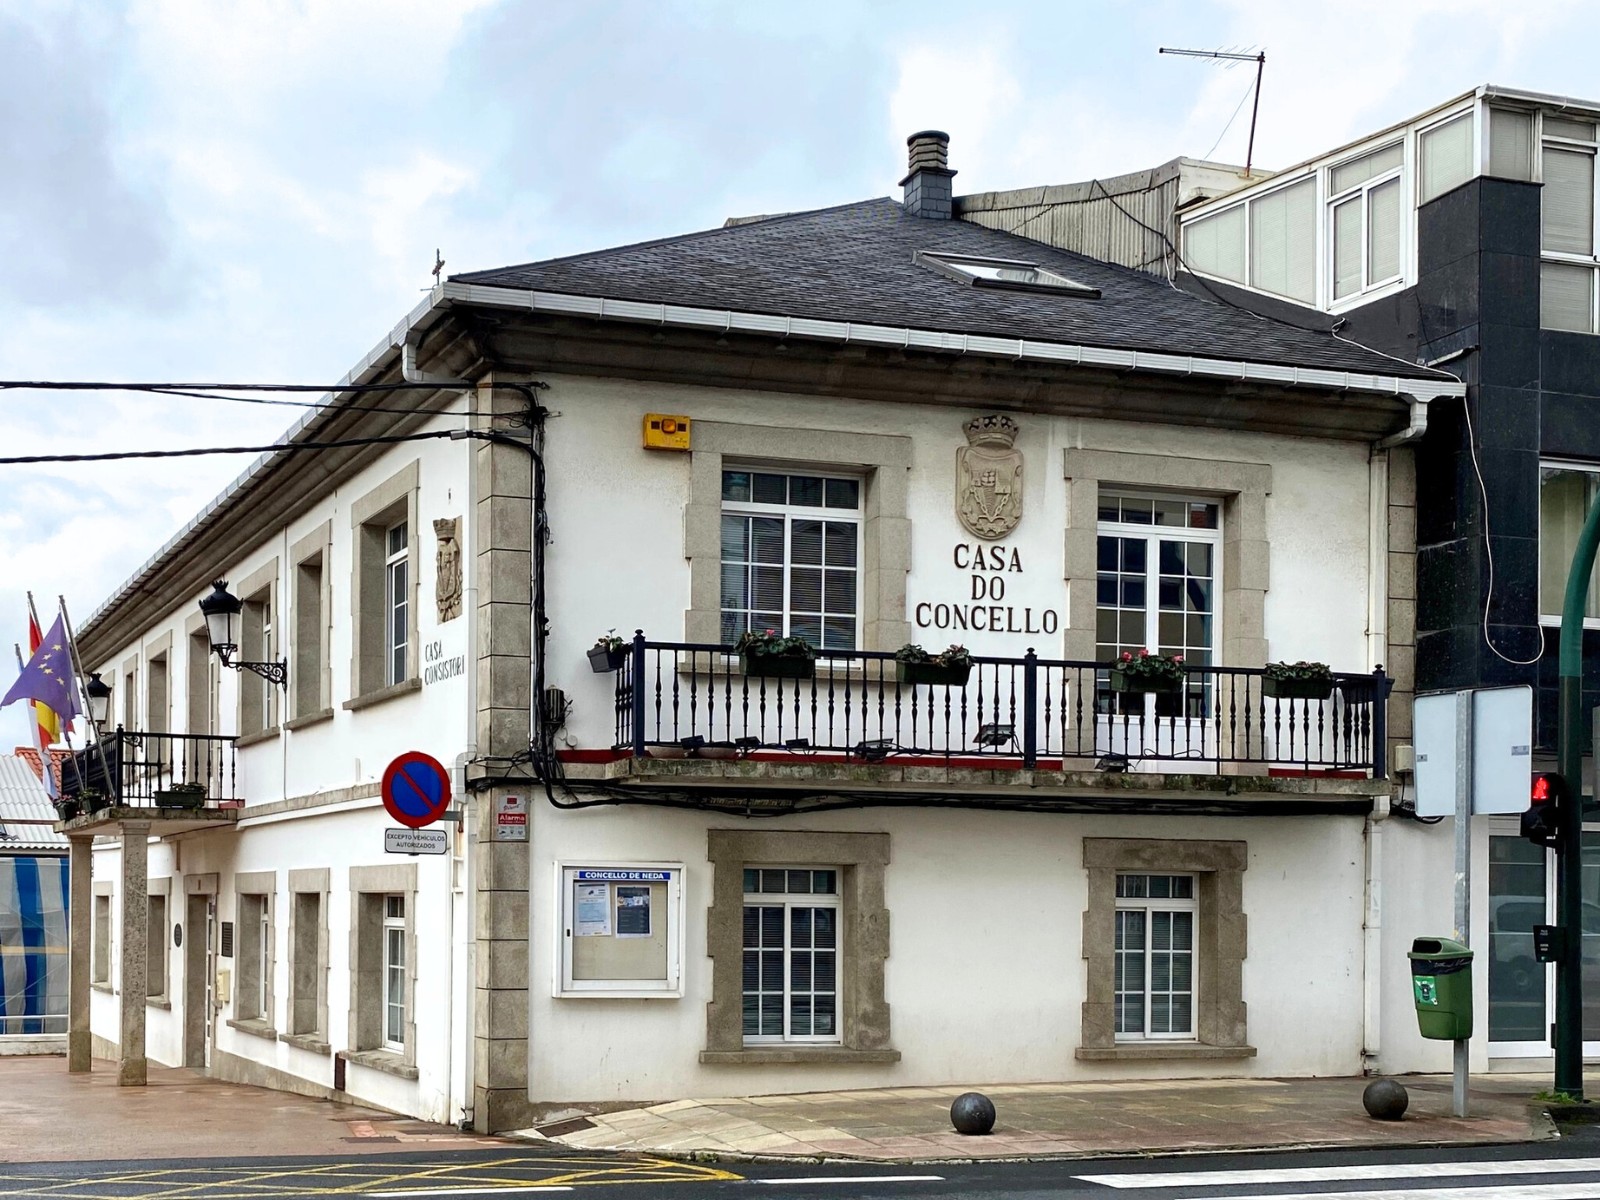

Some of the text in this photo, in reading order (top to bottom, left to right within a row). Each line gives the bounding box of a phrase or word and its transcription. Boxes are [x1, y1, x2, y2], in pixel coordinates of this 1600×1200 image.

[954, 544, 1023, 572] CASA
[971, 574, 1005, 601] DO
[916, 603, 1058, 634] CONCELLO
[425, 640, 442, 662] CASA
